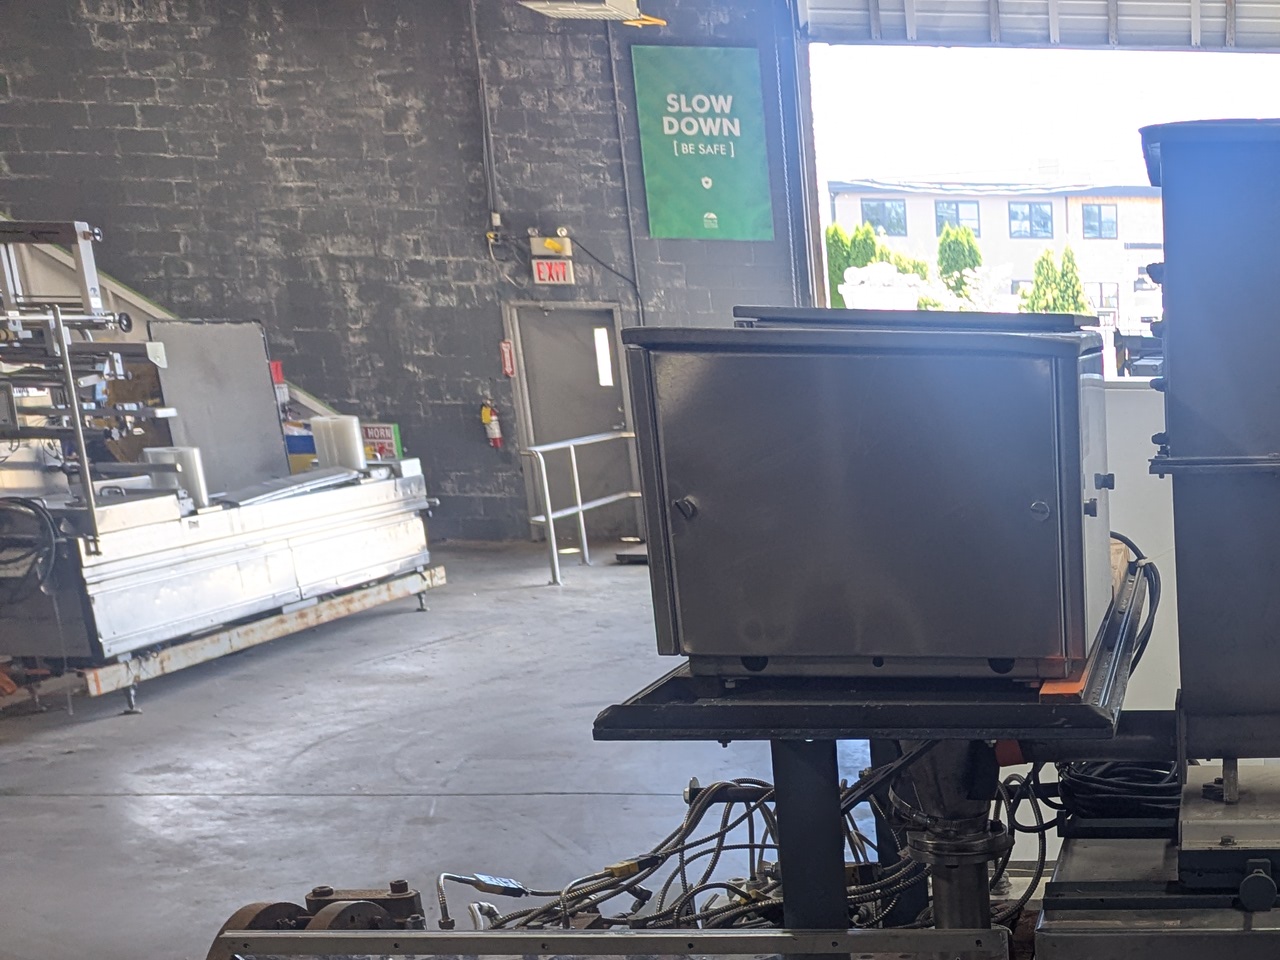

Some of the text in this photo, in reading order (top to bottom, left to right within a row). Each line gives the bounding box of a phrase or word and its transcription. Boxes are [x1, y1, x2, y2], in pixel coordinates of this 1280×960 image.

[666, 93, 733, 114] SLOW
[662, 116, 741, 137] DOWN
[681, 143, 695, 155] BE
[698, 144, 727, 155] SAFE
[536, 261, 567, 282] EXIT
[367, 427, 391, 439] HORN
